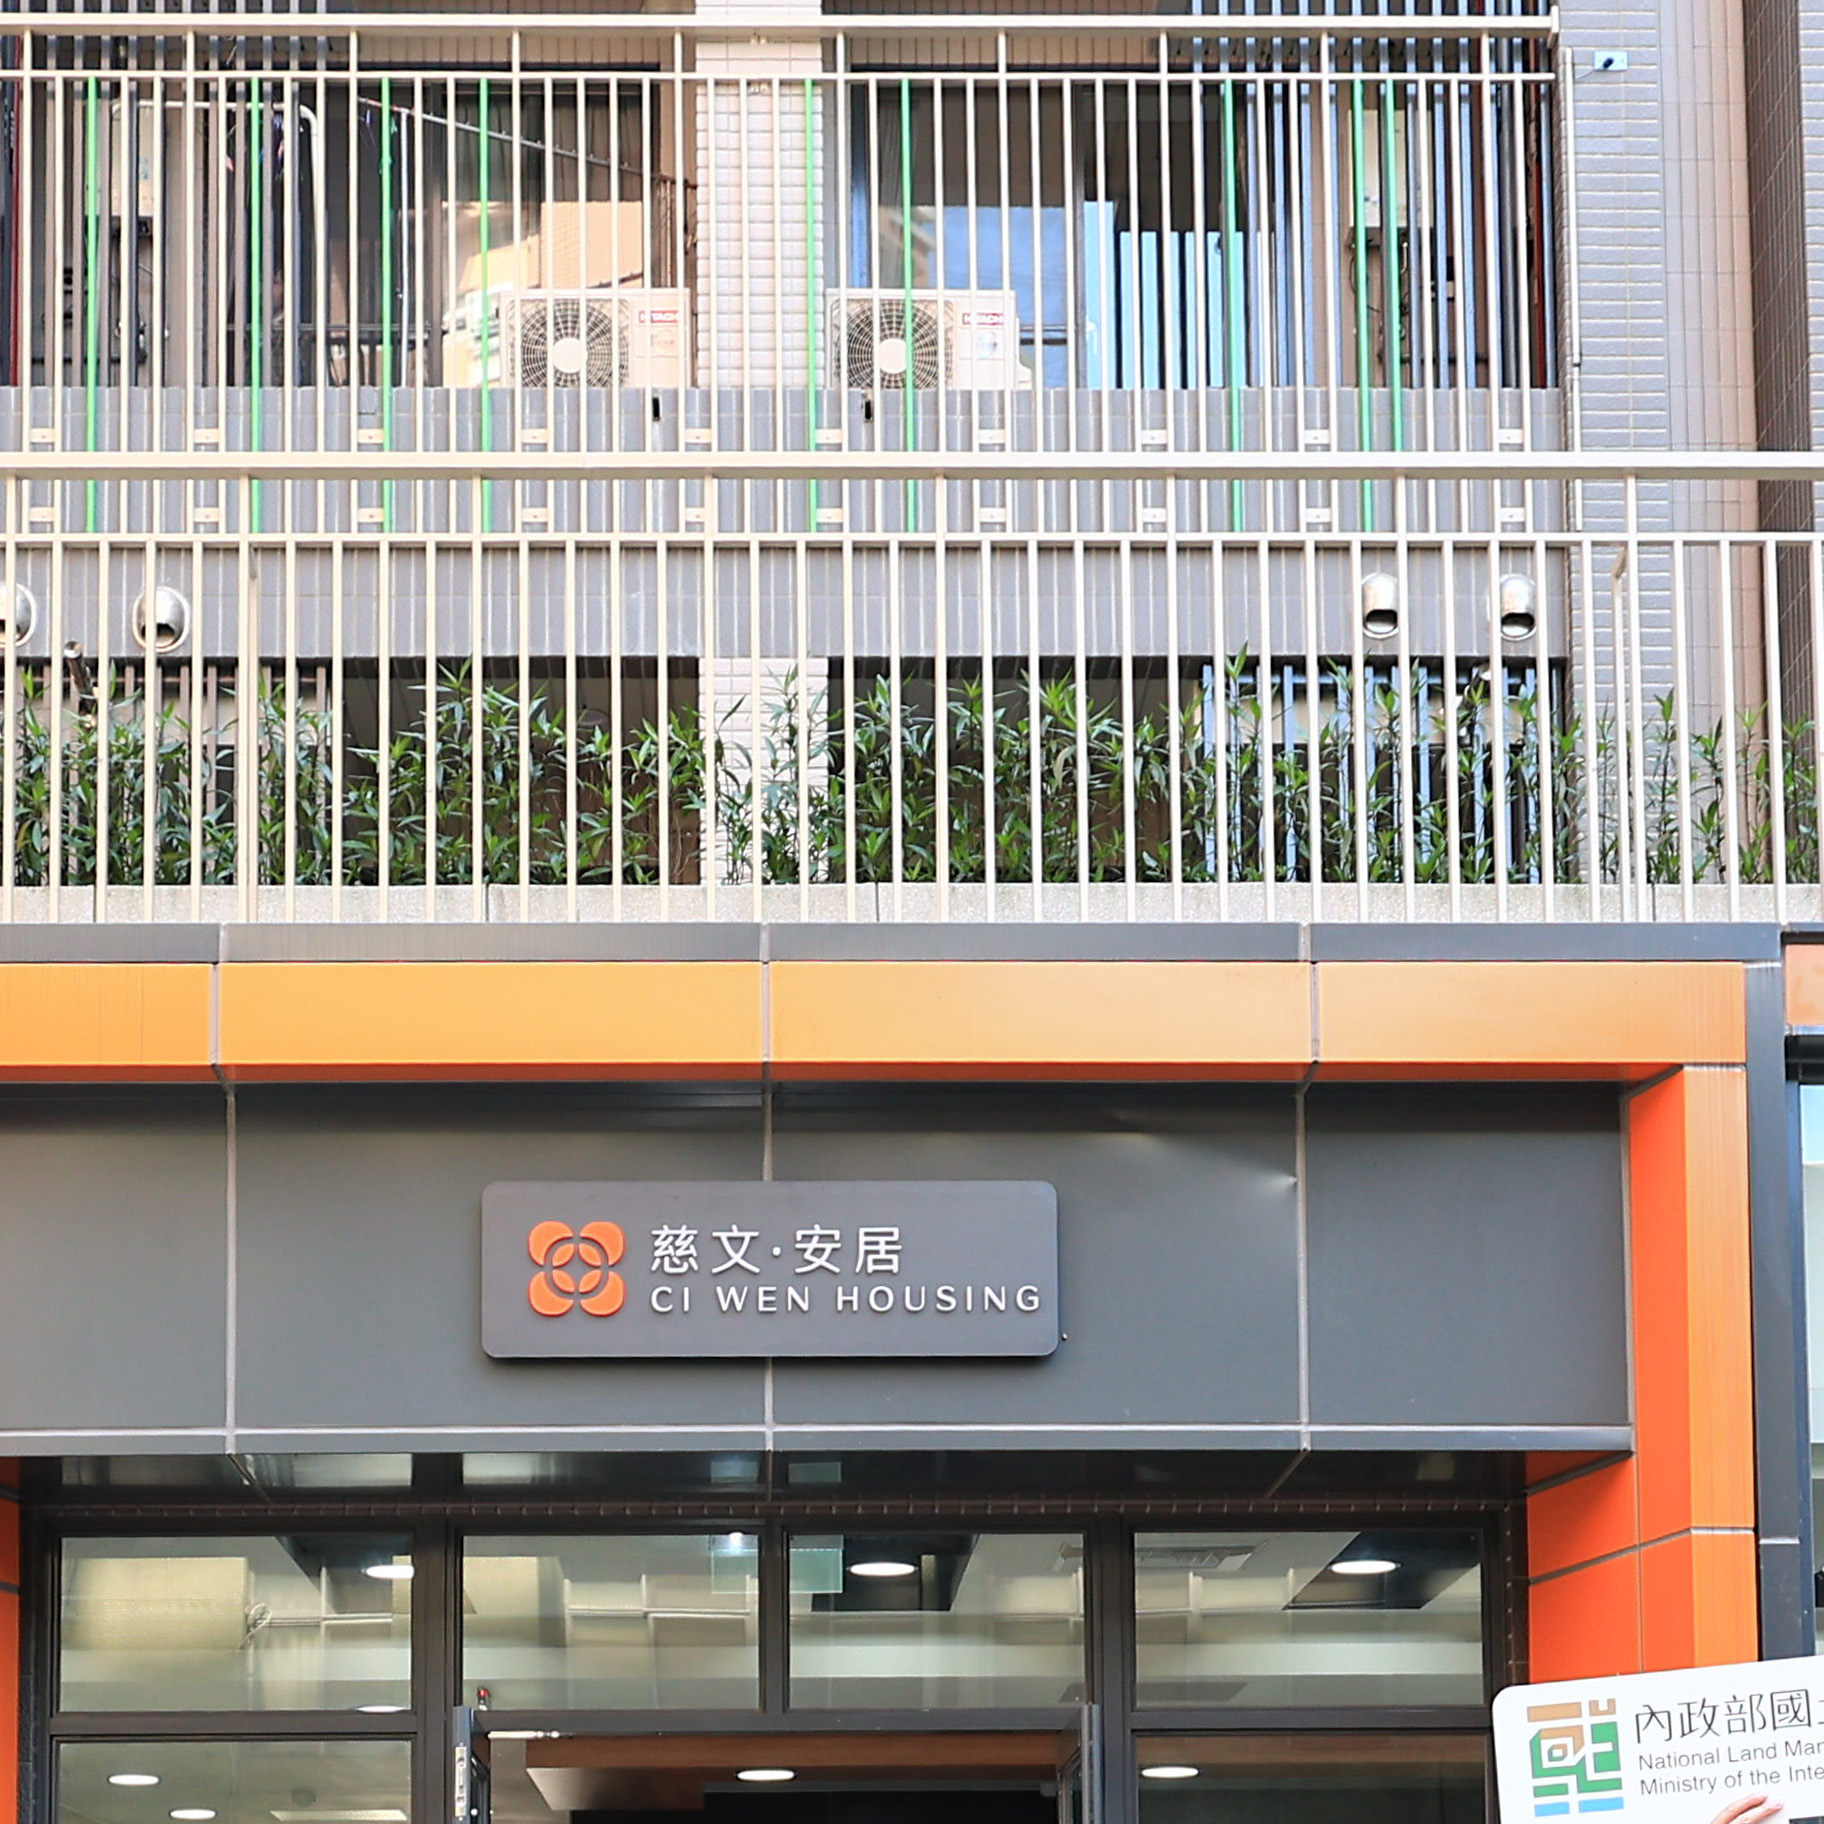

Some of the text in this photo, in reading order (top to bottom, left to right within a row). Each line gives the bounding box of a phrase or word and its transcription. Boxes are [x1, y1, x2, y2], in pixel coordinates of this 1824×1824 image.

[651, 1285, 1041, 1312] CI WEN HOUSING
[1639, 1748, 1721, 1771] National
[1727, 1741, 1777, 1763] Land
[1640, 1773, 1717, 1797] Ministry
[1724, 1770, 1745, 1790] of
[1749, 1767, 1781, 1788] the
